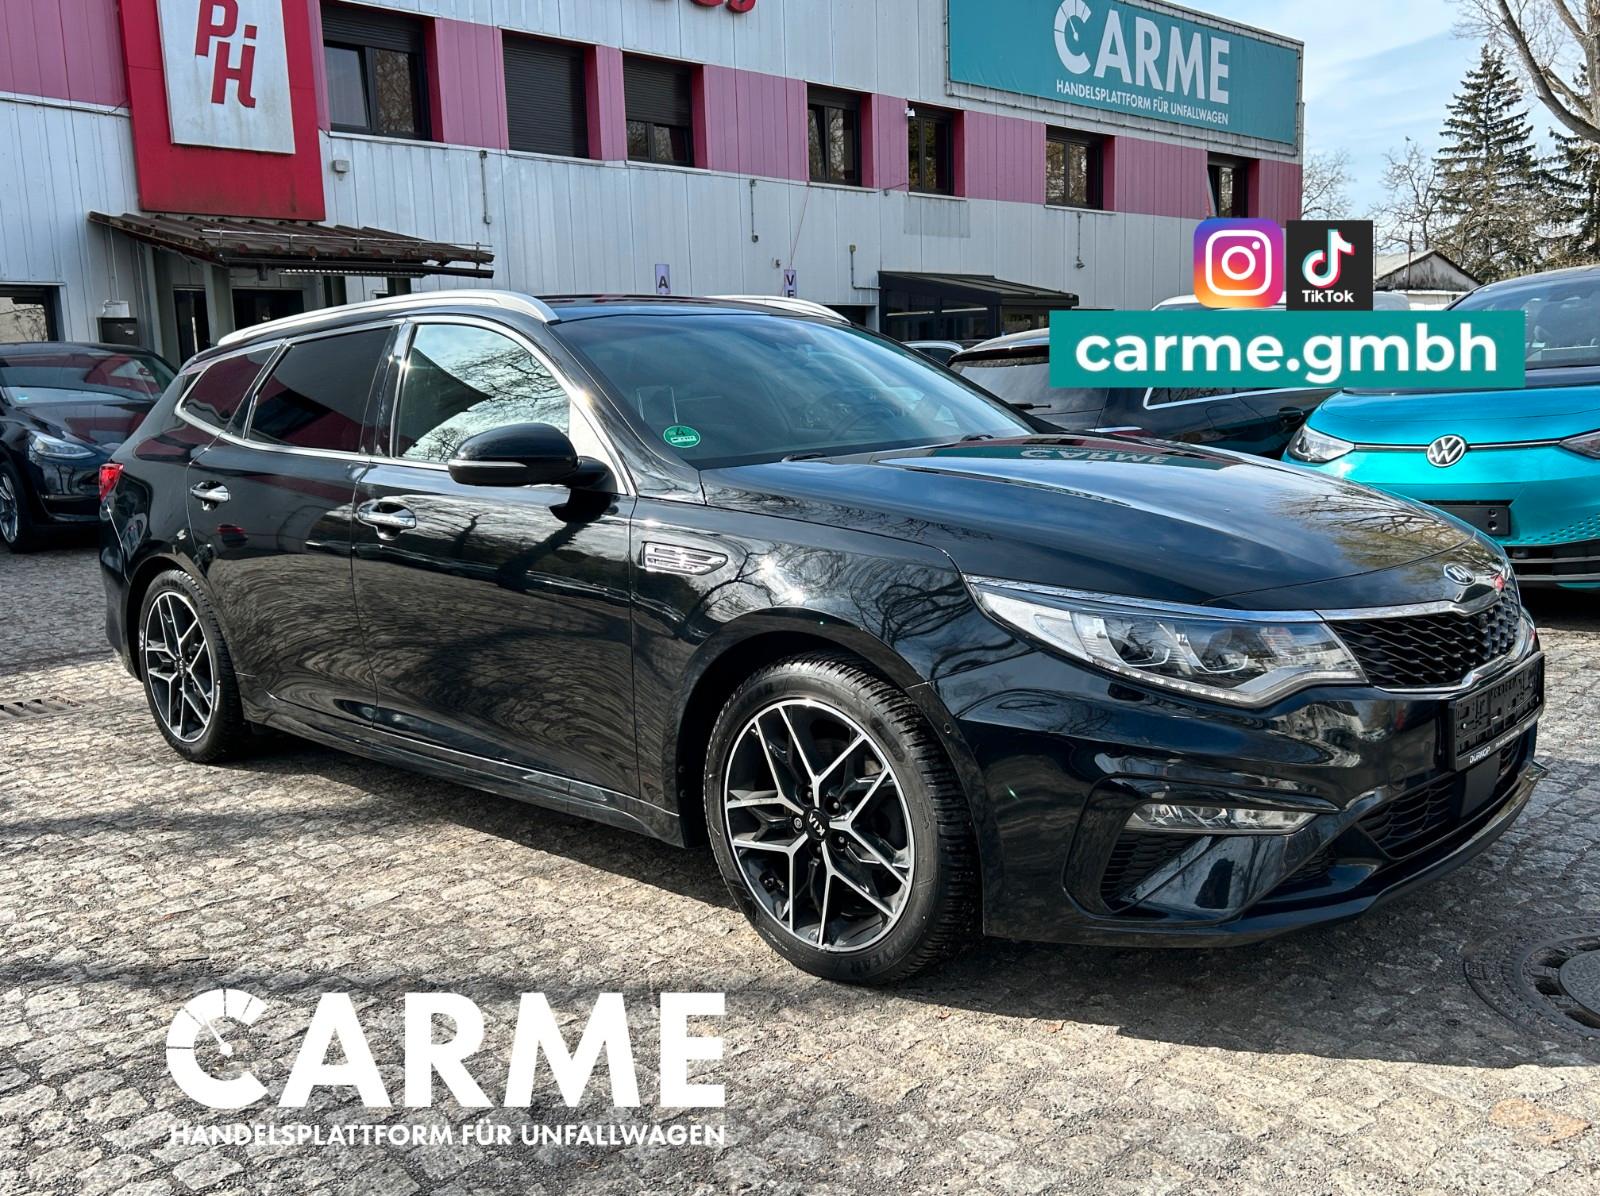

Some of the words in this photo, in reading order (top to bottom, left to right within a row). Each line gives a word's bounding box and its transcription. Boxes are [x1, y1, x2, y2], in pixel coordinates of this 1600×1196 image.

[1054, 0, 1230, 104] CARME
[1056, 79, 1151, 110] HANDELSPLATTFORM
[1152, 97, 1169, 114] FÜR
[1170, 103, 1229, 125] UNFALLWAGEN
